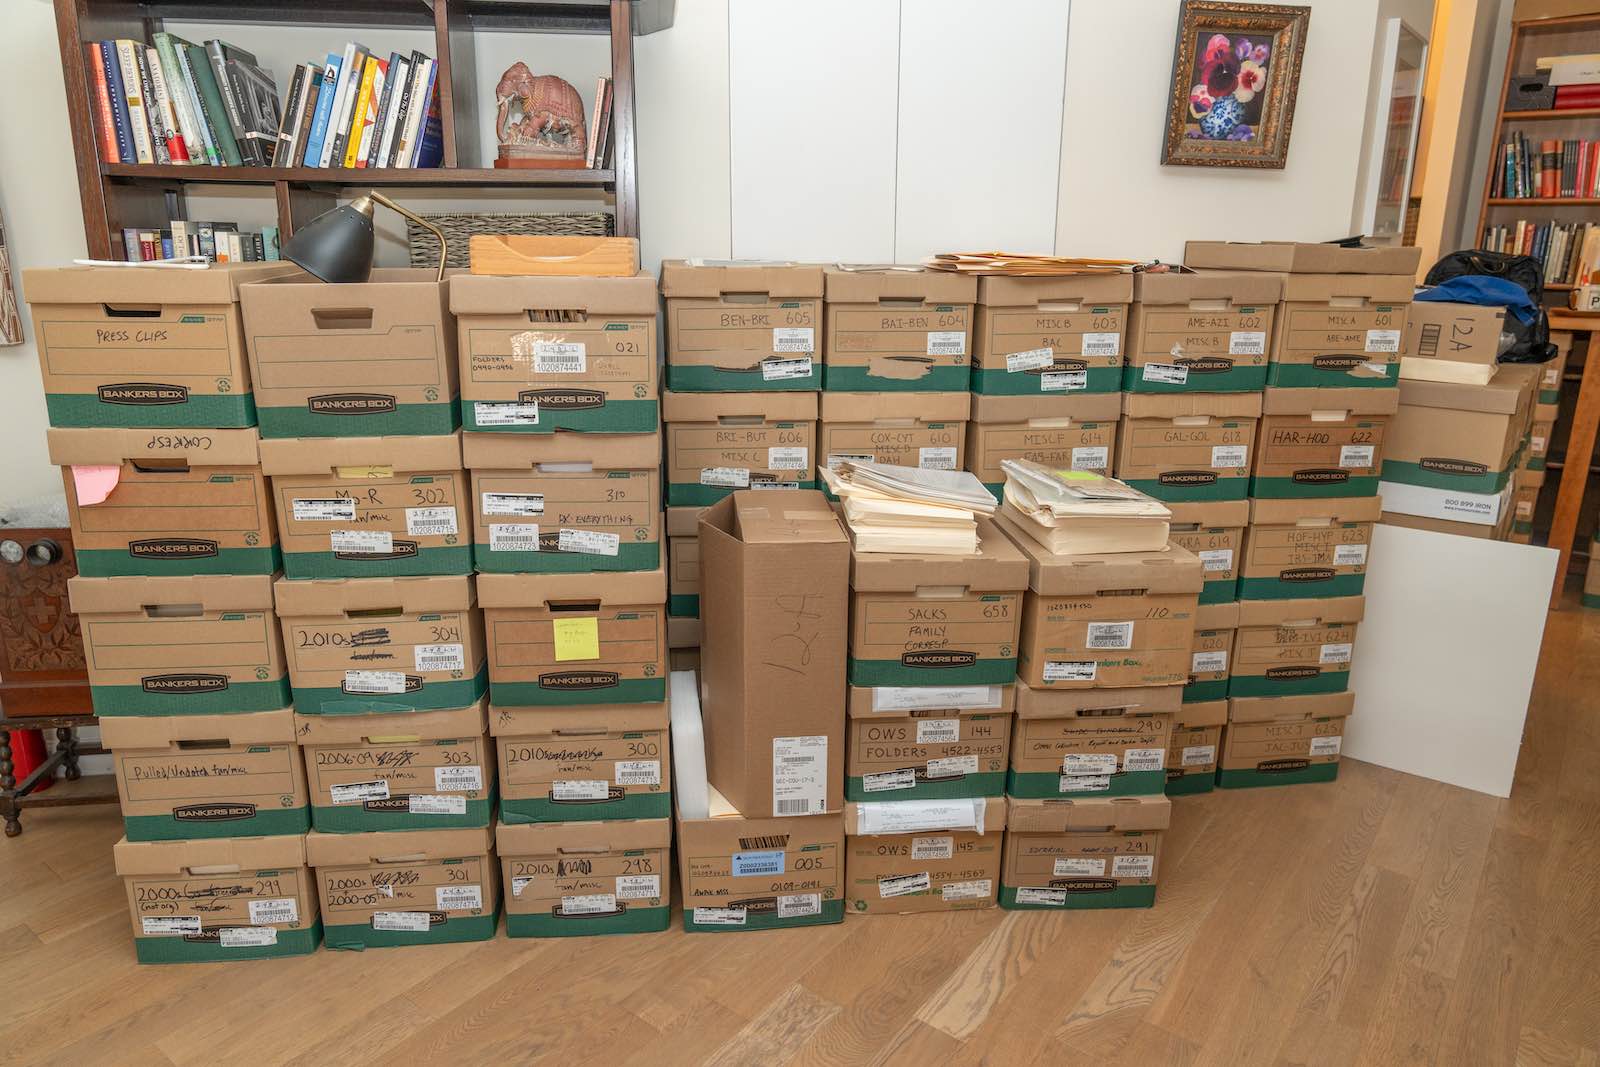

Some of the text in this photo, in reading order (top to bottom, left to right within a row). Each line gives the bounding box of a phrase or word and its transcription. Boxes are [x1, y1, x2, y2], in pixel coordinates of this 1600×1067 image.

[720, 311, 811, 327] BEN-BRI 605
[881, 315, 964, 329] BAI-BEN 604
[1092, 318, 1117, 330] 603
[1240, 317, 1260, 328] 602
[1375, 314, 1391, 325] 601
[97, 329, 168, 344] PRESS CLIPS
[1449, 318, 1475, 351] 12A
[616, 343, 639, 353] 021
[537, 363, 583, 371] 1020874441
[103, 390, 185, 399] BANKERS BOX
[578, 395, 601, 403] BOX
[314, 400, 392, 409] BANKERS BOX
[147, 436, 212, 449] CORRESP
[778, 432, 803, 443] 606
[871, 433, 951, 443] COX-CYT 610
[1080, 433, 1102, 444] 614
[1164, 432, 1240, 442] GAL-GOL 618
[1352, 432, 1372, 442] 622
[1422, 461, 1483, 473] BANKERS BOX
[412, 488, 448, 506] 302
[605, 489, 625, 502] 310
[1342, 530, 1364, 541] 623
[134, 544, 214, 553] BANKERS BOX
[908, 605, 1008, 621] SACKS 658
[1146, 608, 1169, 618] 110
[430, 626, 459, 641] 304
[909, 626, 947, 637] FAMILY
[904, 639, 949, 651] CORRESP
[906, 655, 950, 663] BANKERS
[147, 679, 223, 688] BANKERS BOX
[543, 677, 591, 685] BANKERS
[1136, 720, 1162, 733] 290
[868, 726, 991, 740] OWS 144
[627, 742, 658, 757] 300
[866, 747, 927, 758] FOLDERS
[442, 752, 472, 764] 303
[367, 800, 409, 809] BANKER
[178, 807, 251, 817] BANKERS BOX
[877, 842, 975, 856] OWS 145
[1126, 842, 1148, 852] 291
[622, 859, 652, 874] 298
[795, 858, 824, 871] 005
[445, 869, 469, 881] 301
[256, 880, 282, 896] 299
